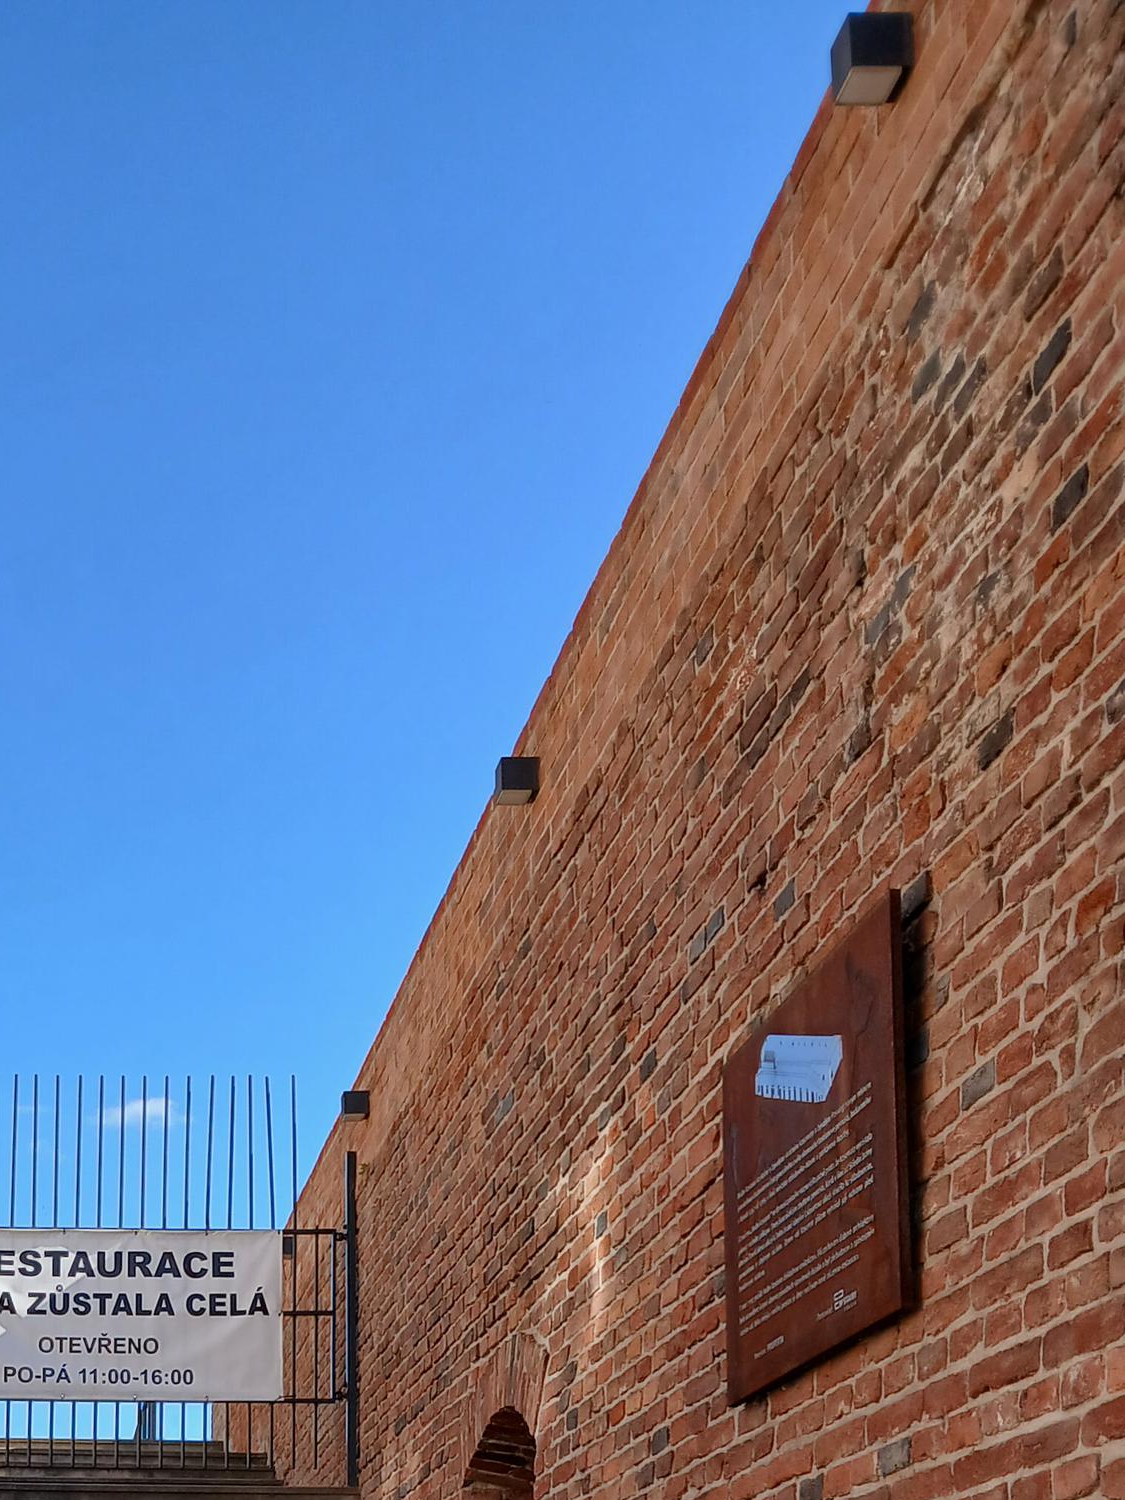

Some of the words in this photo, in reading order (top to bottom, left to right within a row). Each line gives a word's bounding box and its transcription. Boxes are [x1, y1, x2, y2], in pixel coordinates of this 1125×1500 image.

[27, 1284, 176, 1317] ZŮSTALA
[185, 1287, 269, 1317] CELÁ
[38, 1332, 159, 1355] OTEVŘENO
[3, 1363, 71, 1385] PO-PÁ
[79, 1367, 194, 1386] 11:00-16:00
